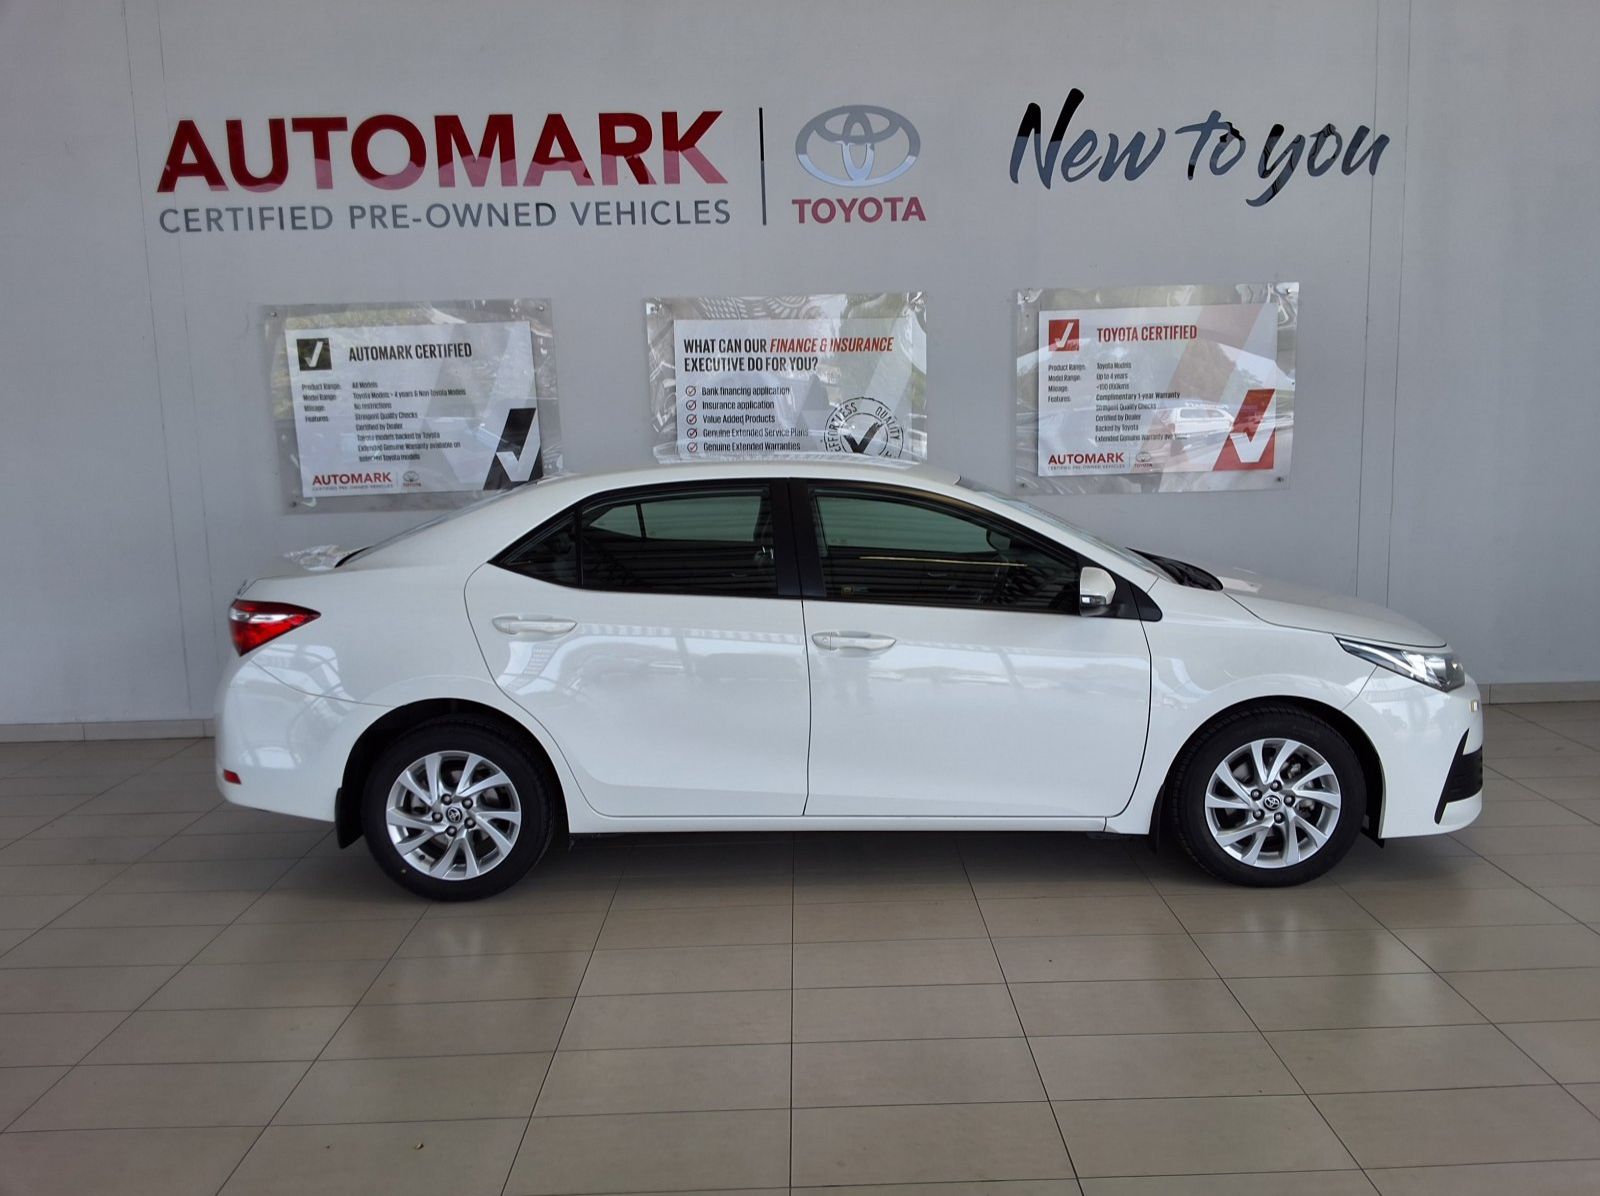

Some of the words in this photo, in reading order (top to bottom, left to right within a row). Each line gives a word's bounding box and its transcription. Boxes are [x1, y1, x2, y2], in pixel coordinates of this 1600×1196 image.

[157, 110, 728, 193] AUTOMARK
[1009, 89, 1166, 190] New
[1174, 109, 1246, 181] to
[1245, 123, 1391, 208] you
[791, 196, 926, 224] TOYOTA
[159, 205, 333, 234] CERTIFIED
[349, 202, 557, 230] PRE-OWNED
[570, 199, 730, 226] VEHICLES
[1097, 326, 1138, 343] TOYOTA
[1141, 325, 1198, 341] CERTIFIED
[684, 339, 716, 354] WHAT
[718, 338, 744, 354] CAN
[744, 338, 767, 353] OUR
[769, 337, 818, 353] FINANCE
[819, 337, 827, 352] &
[829, 336, 894, 353] INSURANCE
[349, 344, 413, 362] AUTOMARK
[415, 342, 472, 359] CERTIFIED
[684, 357, 744, 372] EXECUTIVE
[747, 356, 763, 372] DO
[765, 356, 787, 371] FOR
[788, 356, 818, 372] YOU?
[1096, 362, 1114, 370] Toyota
[1096, 373, 1103, 381] Up
[1114, 373, 1128, 381] years
[301, 383, 323, 391] Product
[359, 381, 378, 389] Models
[353, 392, 371, 400] Toyota
[371, 391, 390, 399] Models
[398, 391, 413, 399] years
[430, 389, 447, 397] Toyota
[447, 388, 466, 396] Models
[701, 386, 719, 396] Bank
[719, 386, 752, 397] financing
[752, 386, 790, 397] application
[1095, 393, 1137, 401] Complimentary
[1154, 391, 1181, 399] Warranty
[361, 402, 392, 410] restrictions
[702, 400, 736, 410] Insurance
[736, 400, 775, 411] application
[380, 412, 398, 420] Quality
[398, 411, 418, 419] Checks
[703, 414, 721, 424] Value
[722, 414, 744, 424] Added
[745, 414, 776, 424] Products
[1095, 414, 1117, 422] Certified
[1124, 413, 1141, 421] Dealer
[355, 423, 379, 431] Certified
[875, 406, 900, 440] QUALITY
[703, 429, 731, 438] Genuine
[731, 428, 763, 438] Extended
[764, 428, 790, 437] Service
[790, 427, 809, 437] Plans
[703, 442, 731, 451] Genuine
[731, 442, 764, 451] Extended
[764, 441, 801, 451] Warranties
[1048, 452, 1124, 465] AUTOMARK
[312, 472, 392, 486] AUTOMARK
